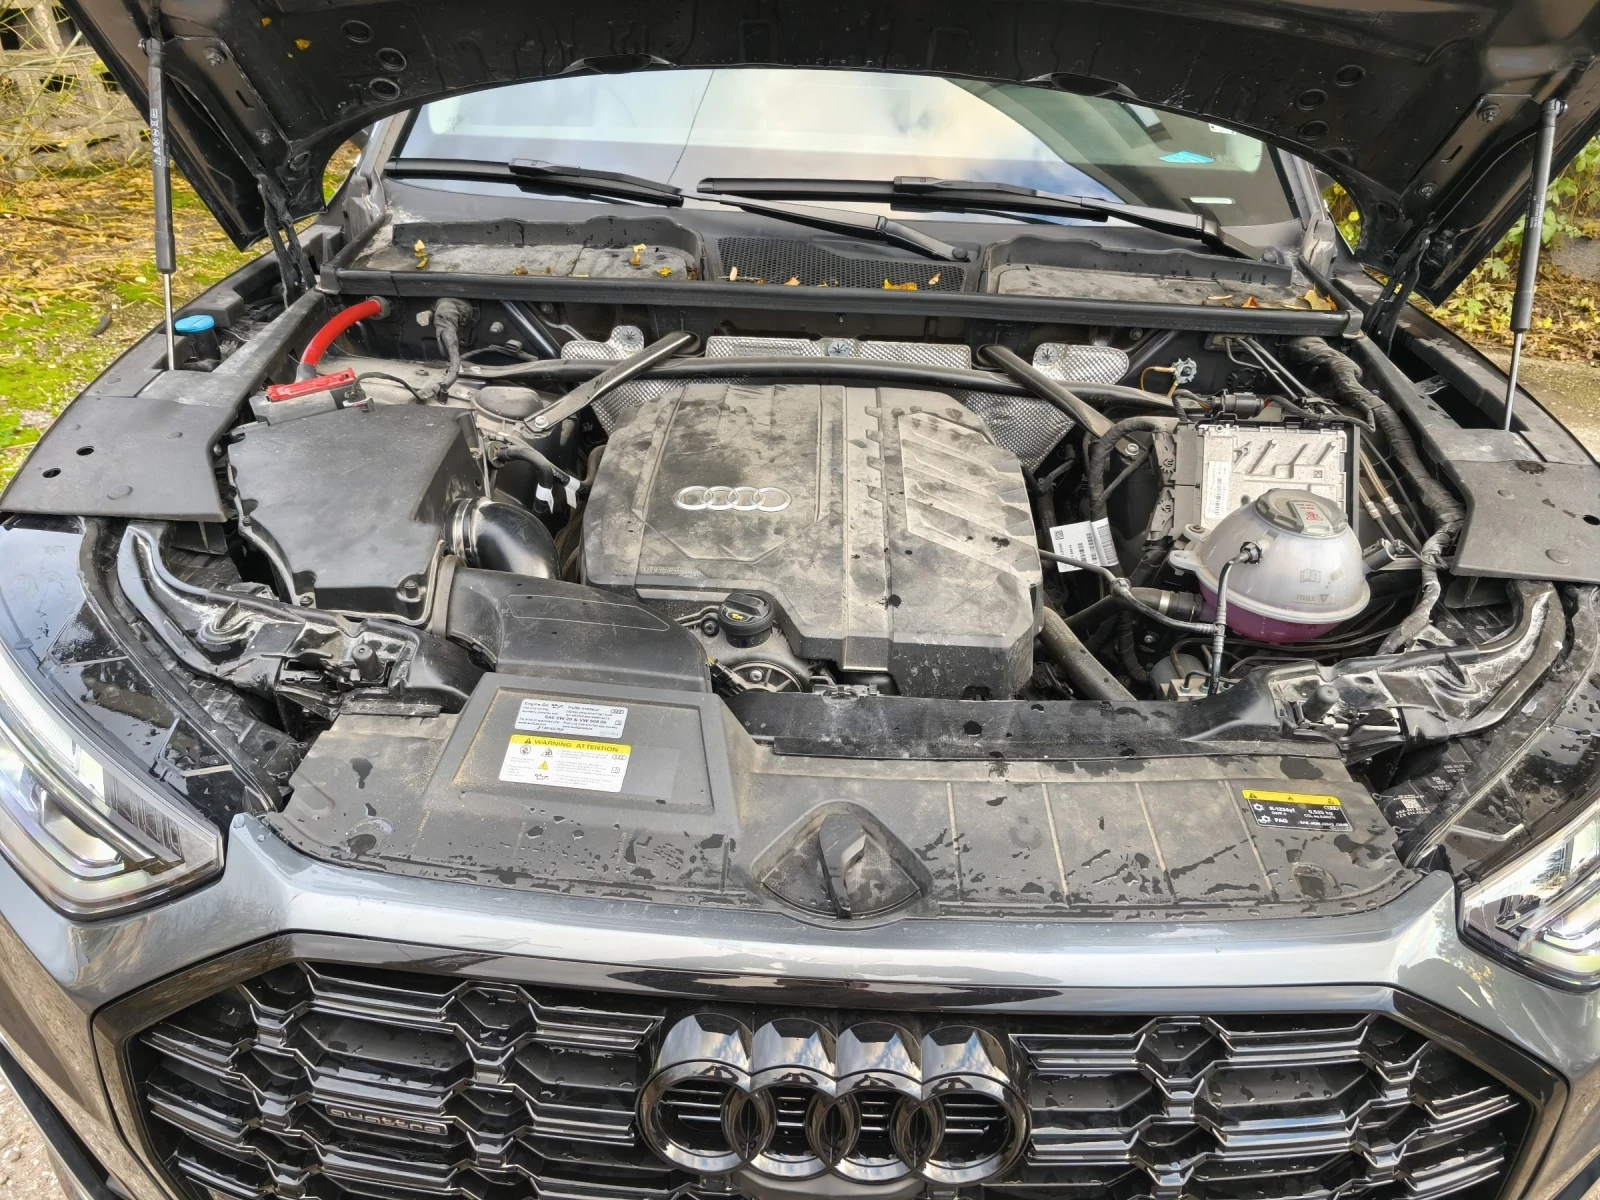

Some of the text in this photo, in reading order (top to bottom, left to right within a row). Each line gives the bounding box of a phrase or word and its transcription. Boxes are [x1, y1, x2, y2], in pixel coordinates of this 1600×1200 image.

[1296, 594, 1316, 602] max
[534, 739, 619, 753] WARNING ATTENTION
[330, 1108, 442, 1135] quattro
